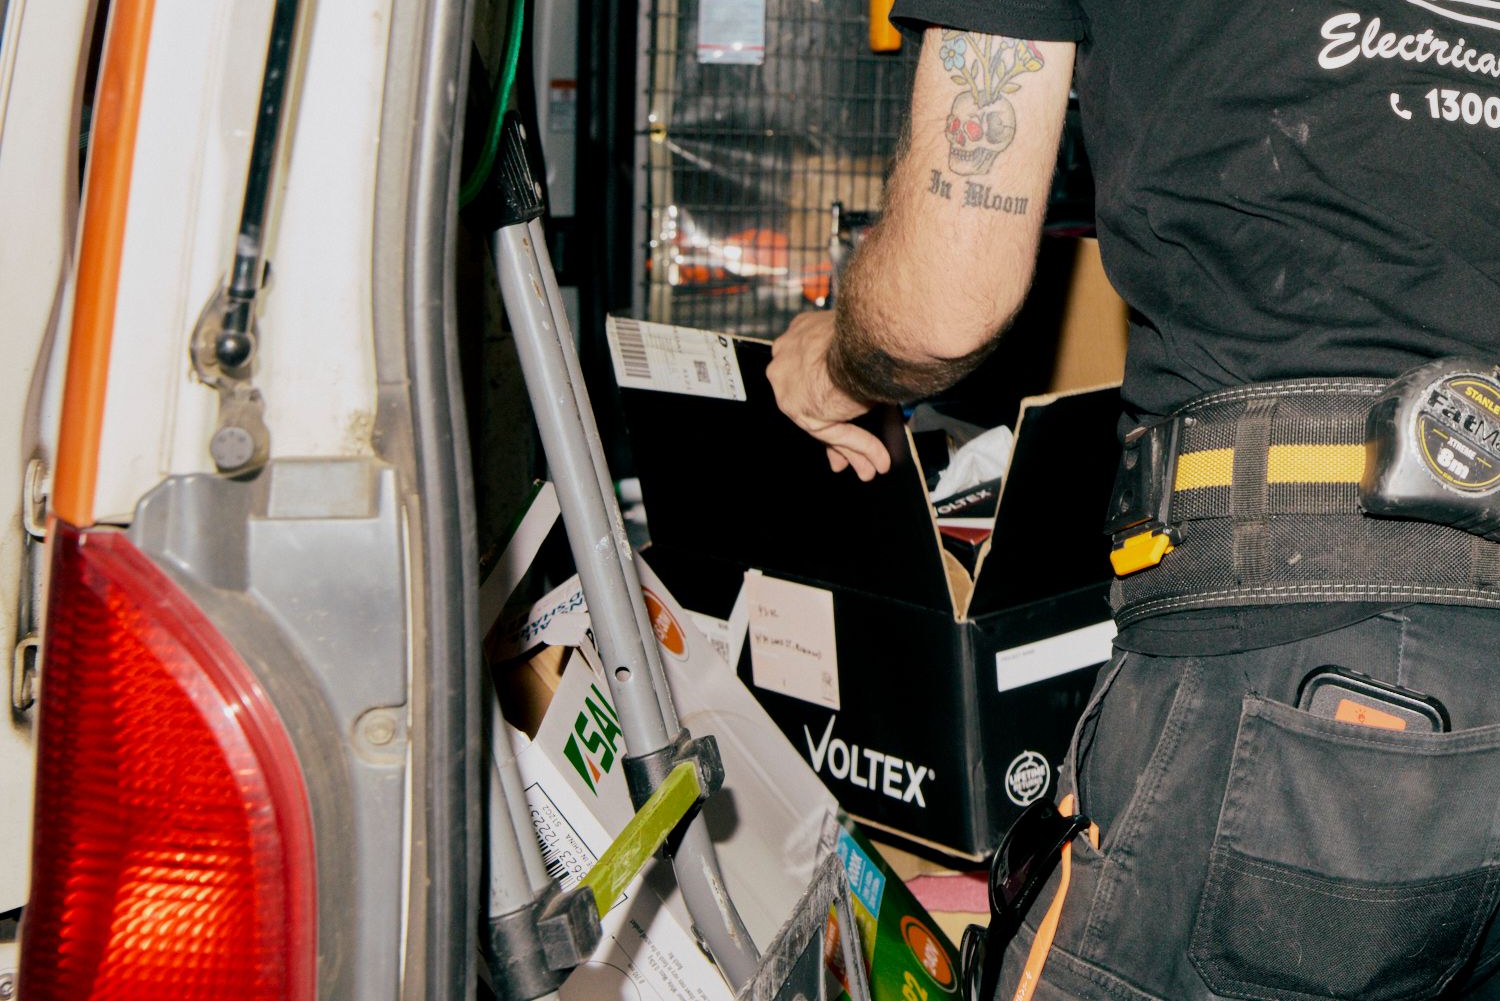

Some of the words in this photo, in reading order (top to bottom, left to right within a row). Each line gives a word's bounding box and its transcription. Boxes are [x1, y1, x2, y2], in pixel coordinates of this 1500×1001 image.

[929, 169, 952, 199] In
[962, 181, 1028, 215] Bloom
[1447, 437, 1478, 460] XTREME
[1437, 447, 1470, 479] 8m
[804, 714, 926, 808] VOLTEX
[1010, 764, 1046, 785] LIFETIME
[564, 833, 582, 855] CHINA
